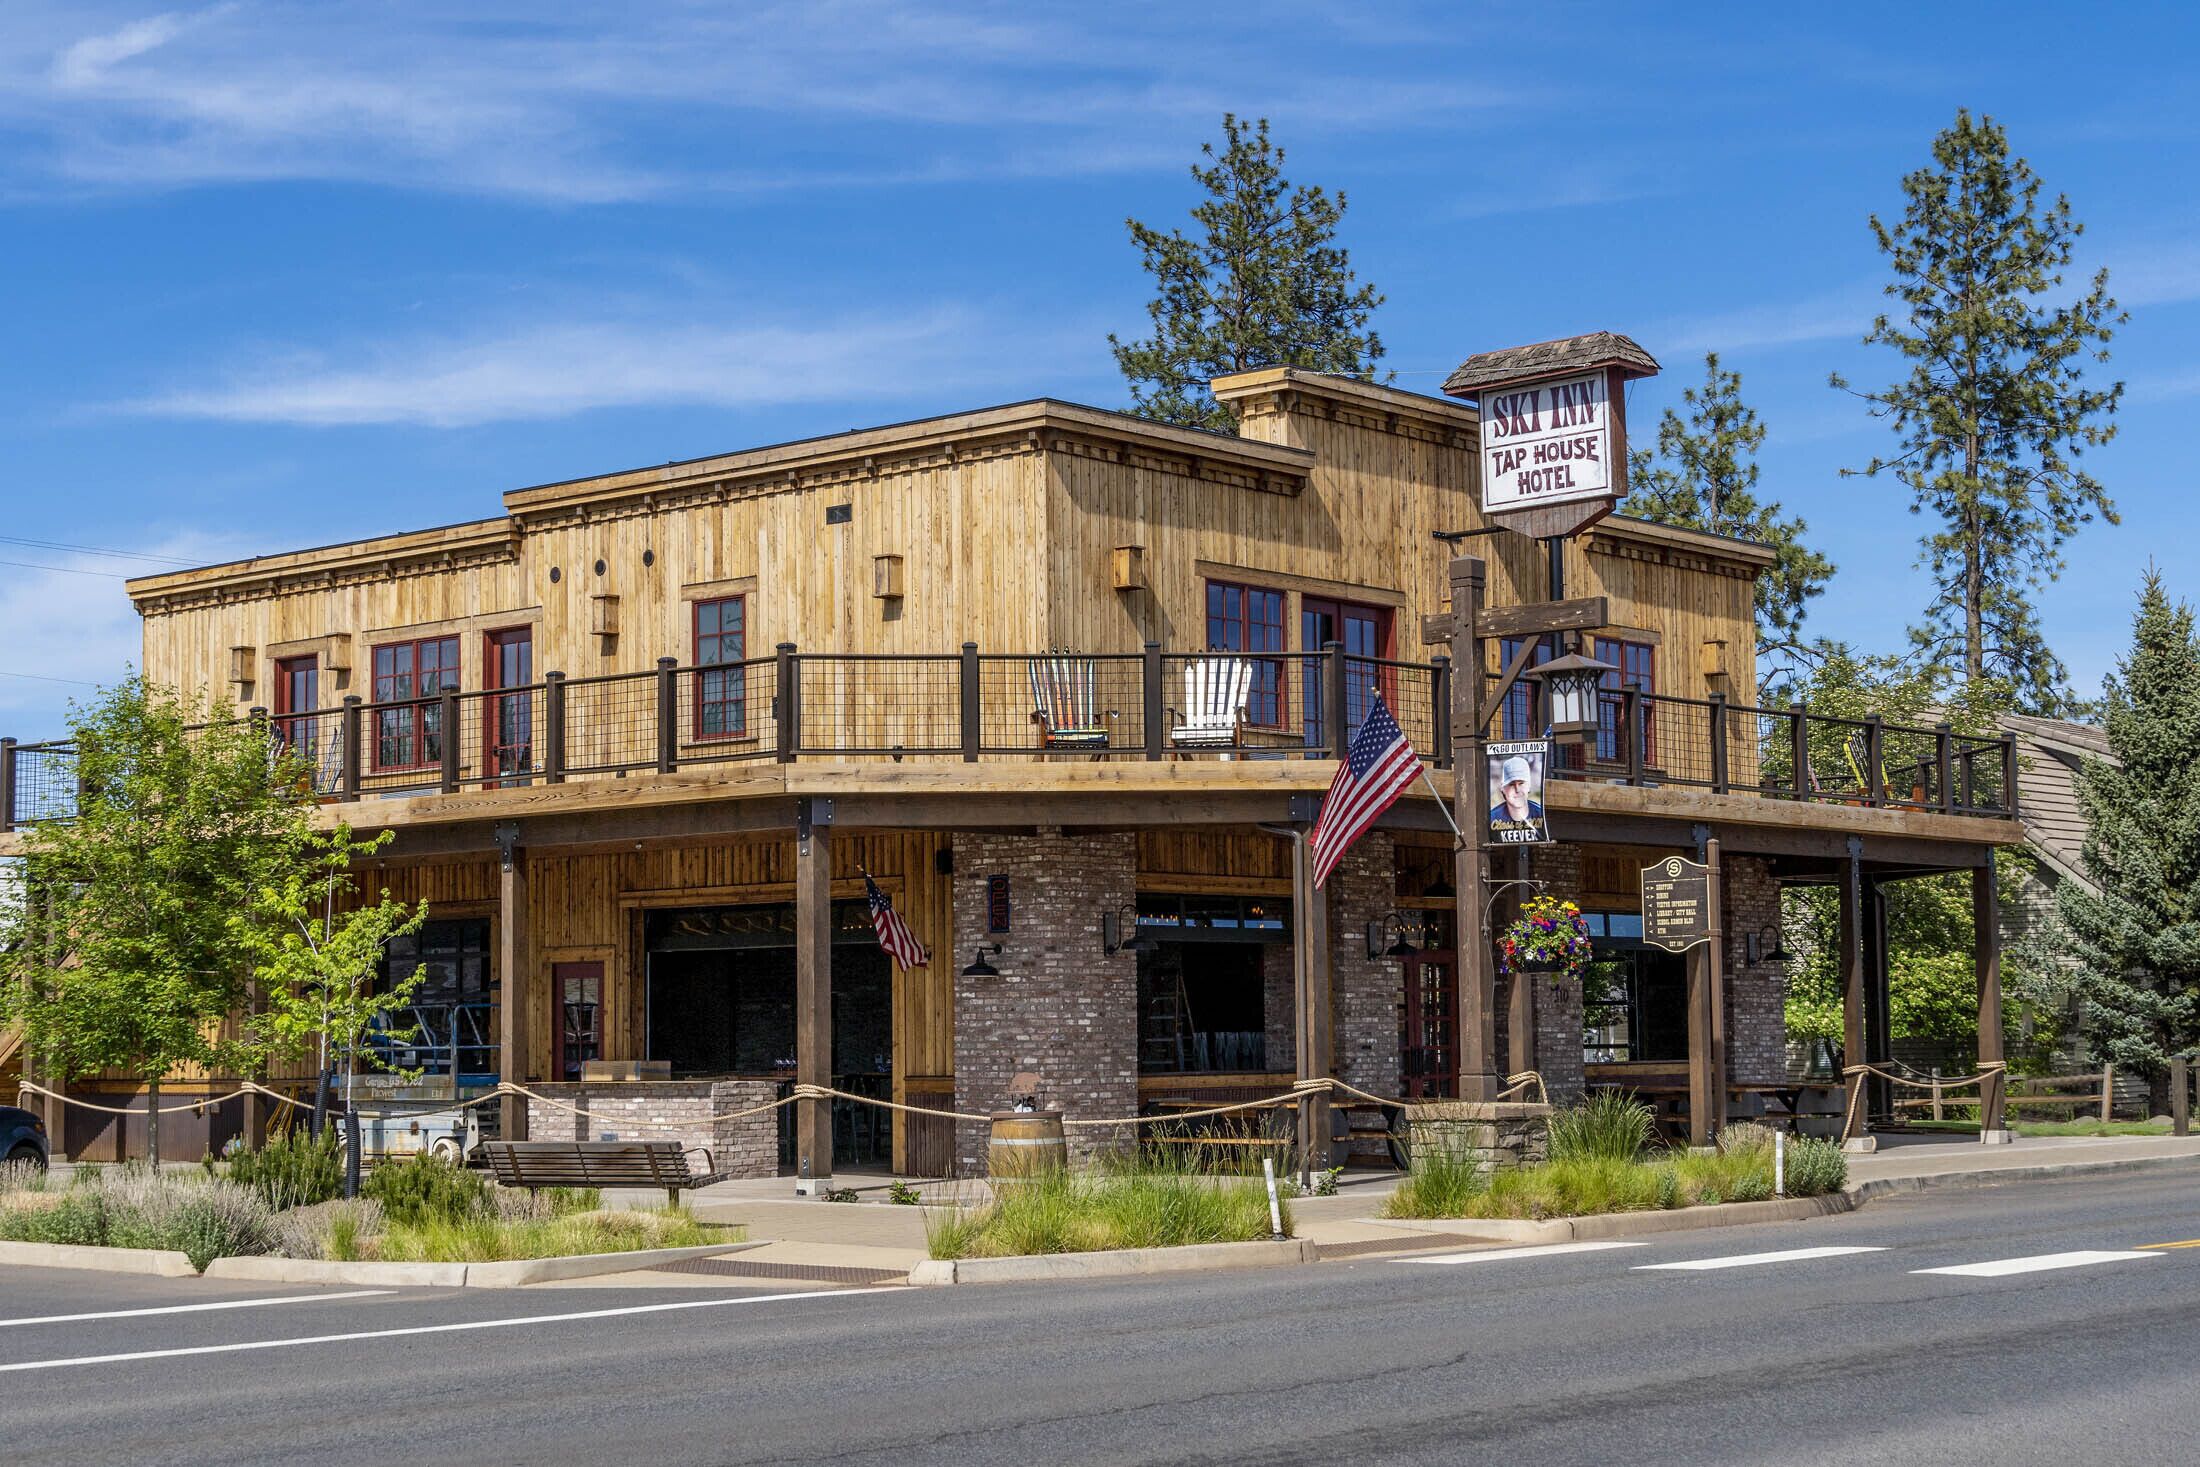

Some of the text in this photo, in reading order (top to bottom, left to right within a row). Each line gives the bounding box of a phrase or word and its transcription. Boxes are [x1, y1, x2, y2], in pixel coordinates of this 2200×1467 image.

[1493, 380, 1595, 438] SKI INN
[1492, 436, 1599, 478] TAP HOUSE
[1518, 465, 1575, 495] HOTEL
[1500, 743, 1545, 753] GO OUTLAWS
[1500, 829, 1539, 843] KEEVER
